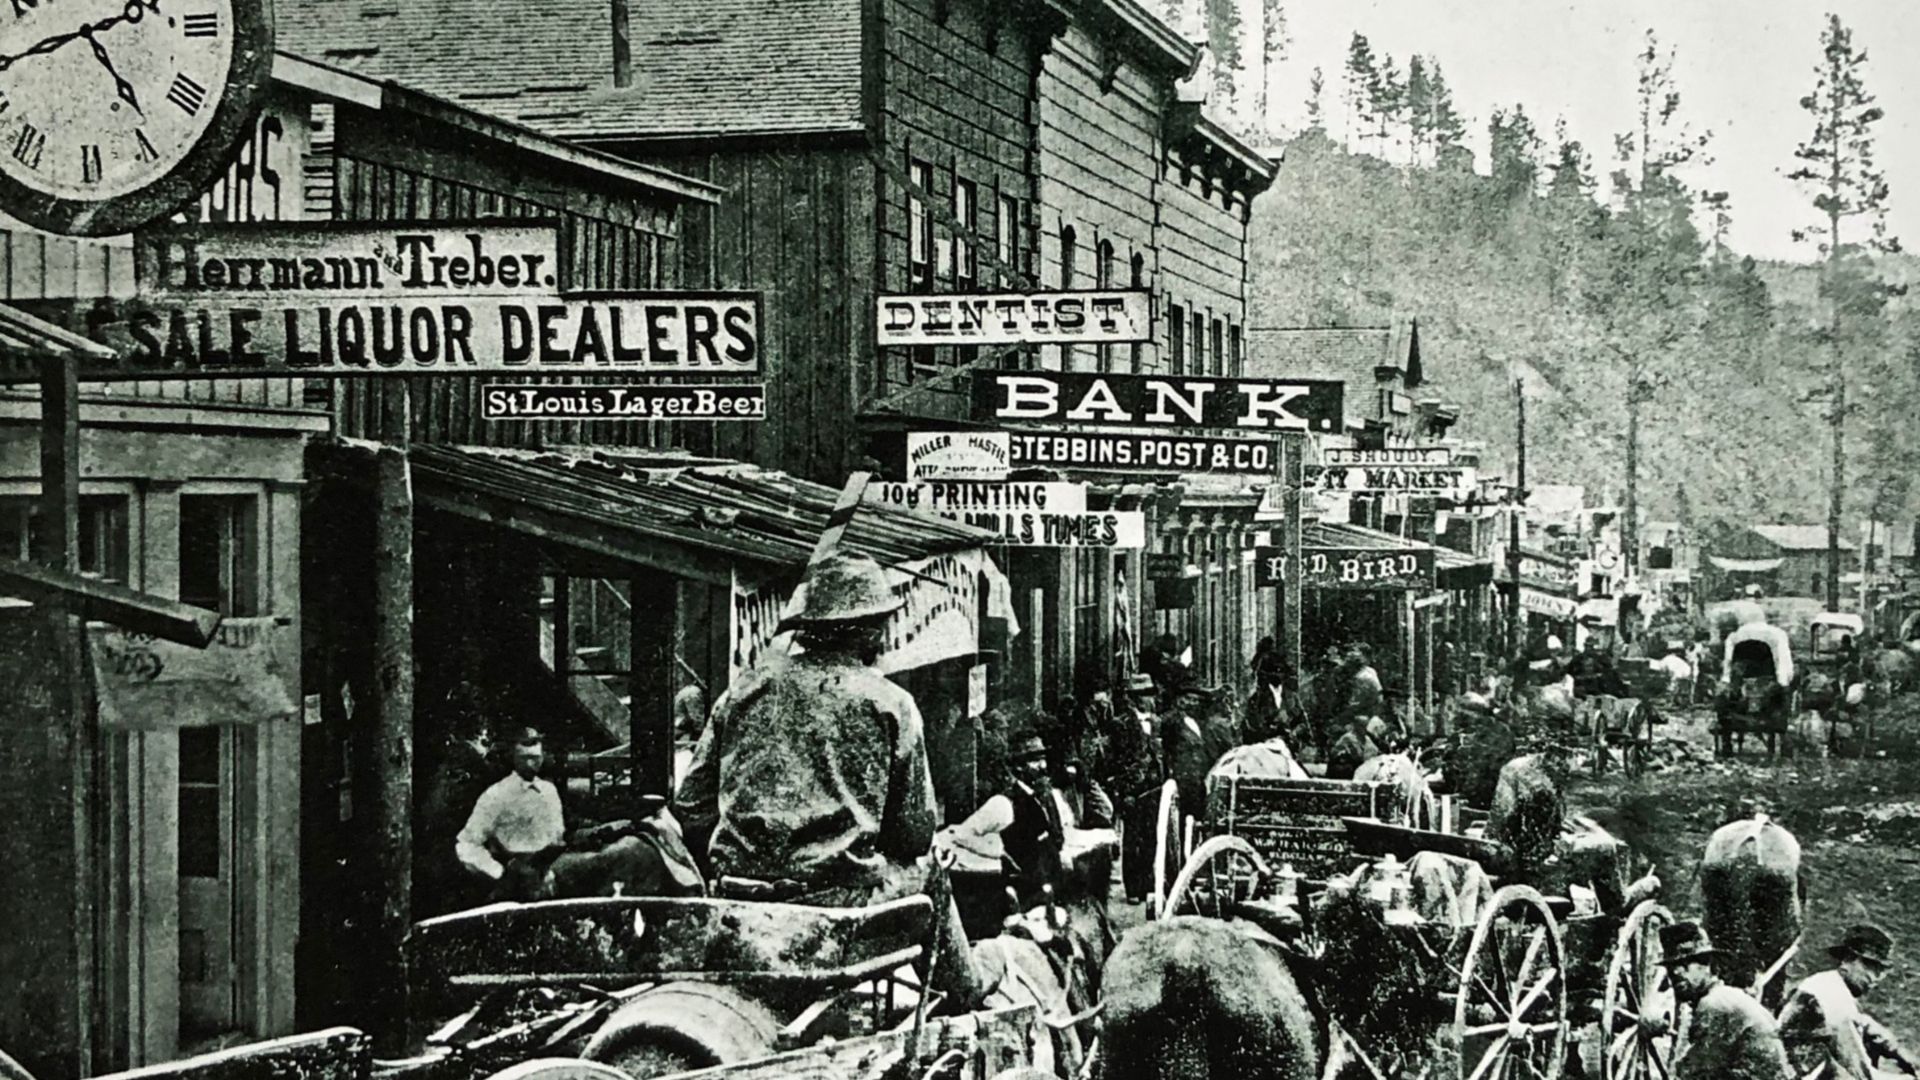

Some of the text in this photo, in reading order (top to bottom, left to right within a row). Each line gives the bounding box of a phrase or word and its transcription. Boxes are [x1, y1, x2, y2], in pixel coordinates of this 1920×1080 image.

[152, 238, 384, 291] Herrmann
[396, 234, 556, 288] Treber.
[283, 305, 477, 368] LIQUOR
[500, 304, 757, 366] DEALERS
[996, 376, 1332, 429] BANK.
[911, 434, 951, 463] MILLER
[931, 483, 1047, 510] PRINTING
